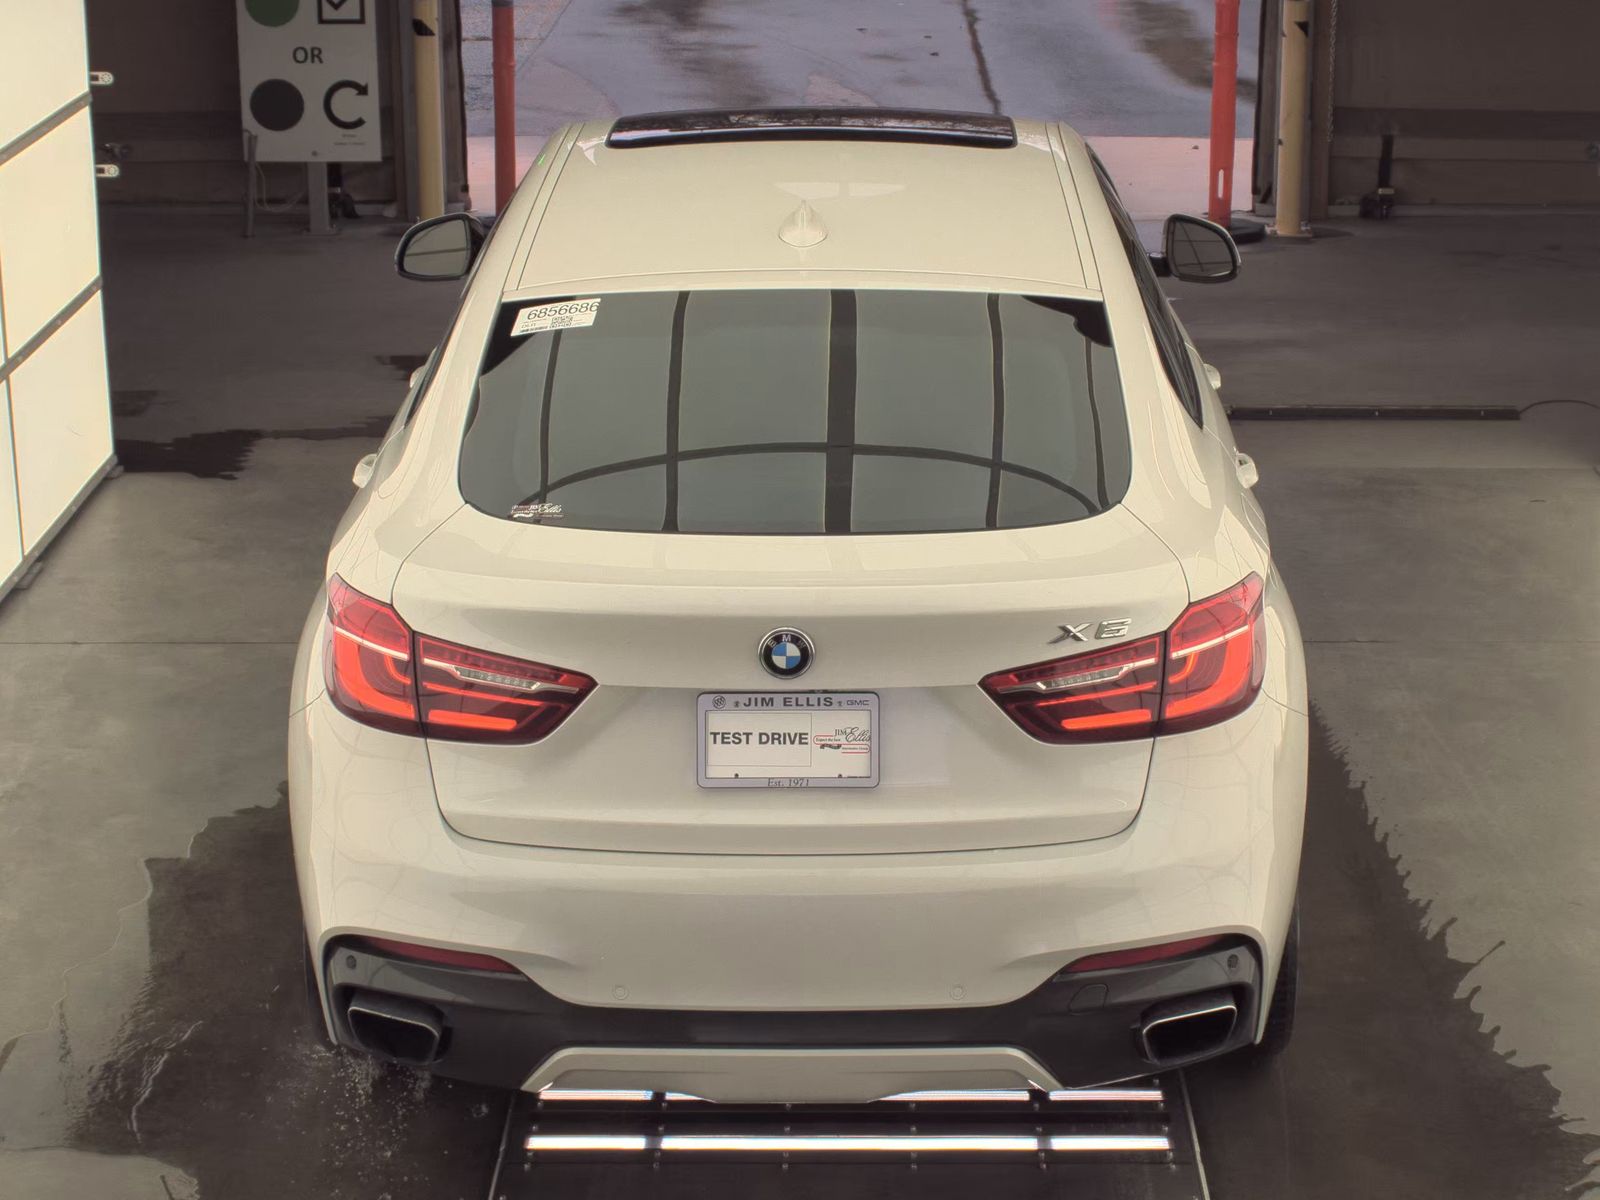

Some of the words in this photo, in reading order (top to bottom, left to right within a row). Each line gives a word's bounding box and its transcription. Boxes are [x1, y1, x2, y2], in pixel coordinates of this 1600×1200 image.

[292, 46, 324, 64] OR
[526, 301, 600, 320] 6856686
[1047, 618, 1132, 645] X6
[767, 634, 807, 649] BMW
[743, 697, 775, 707] JIM
[783, 696, 833, 707] ELLIS
[709, 731, 753, 745] TEST
[758, 732, 809, 745] DRIVE
[834, 728, 848, 737] JIM
[788, 777, 809, 787] 1971
